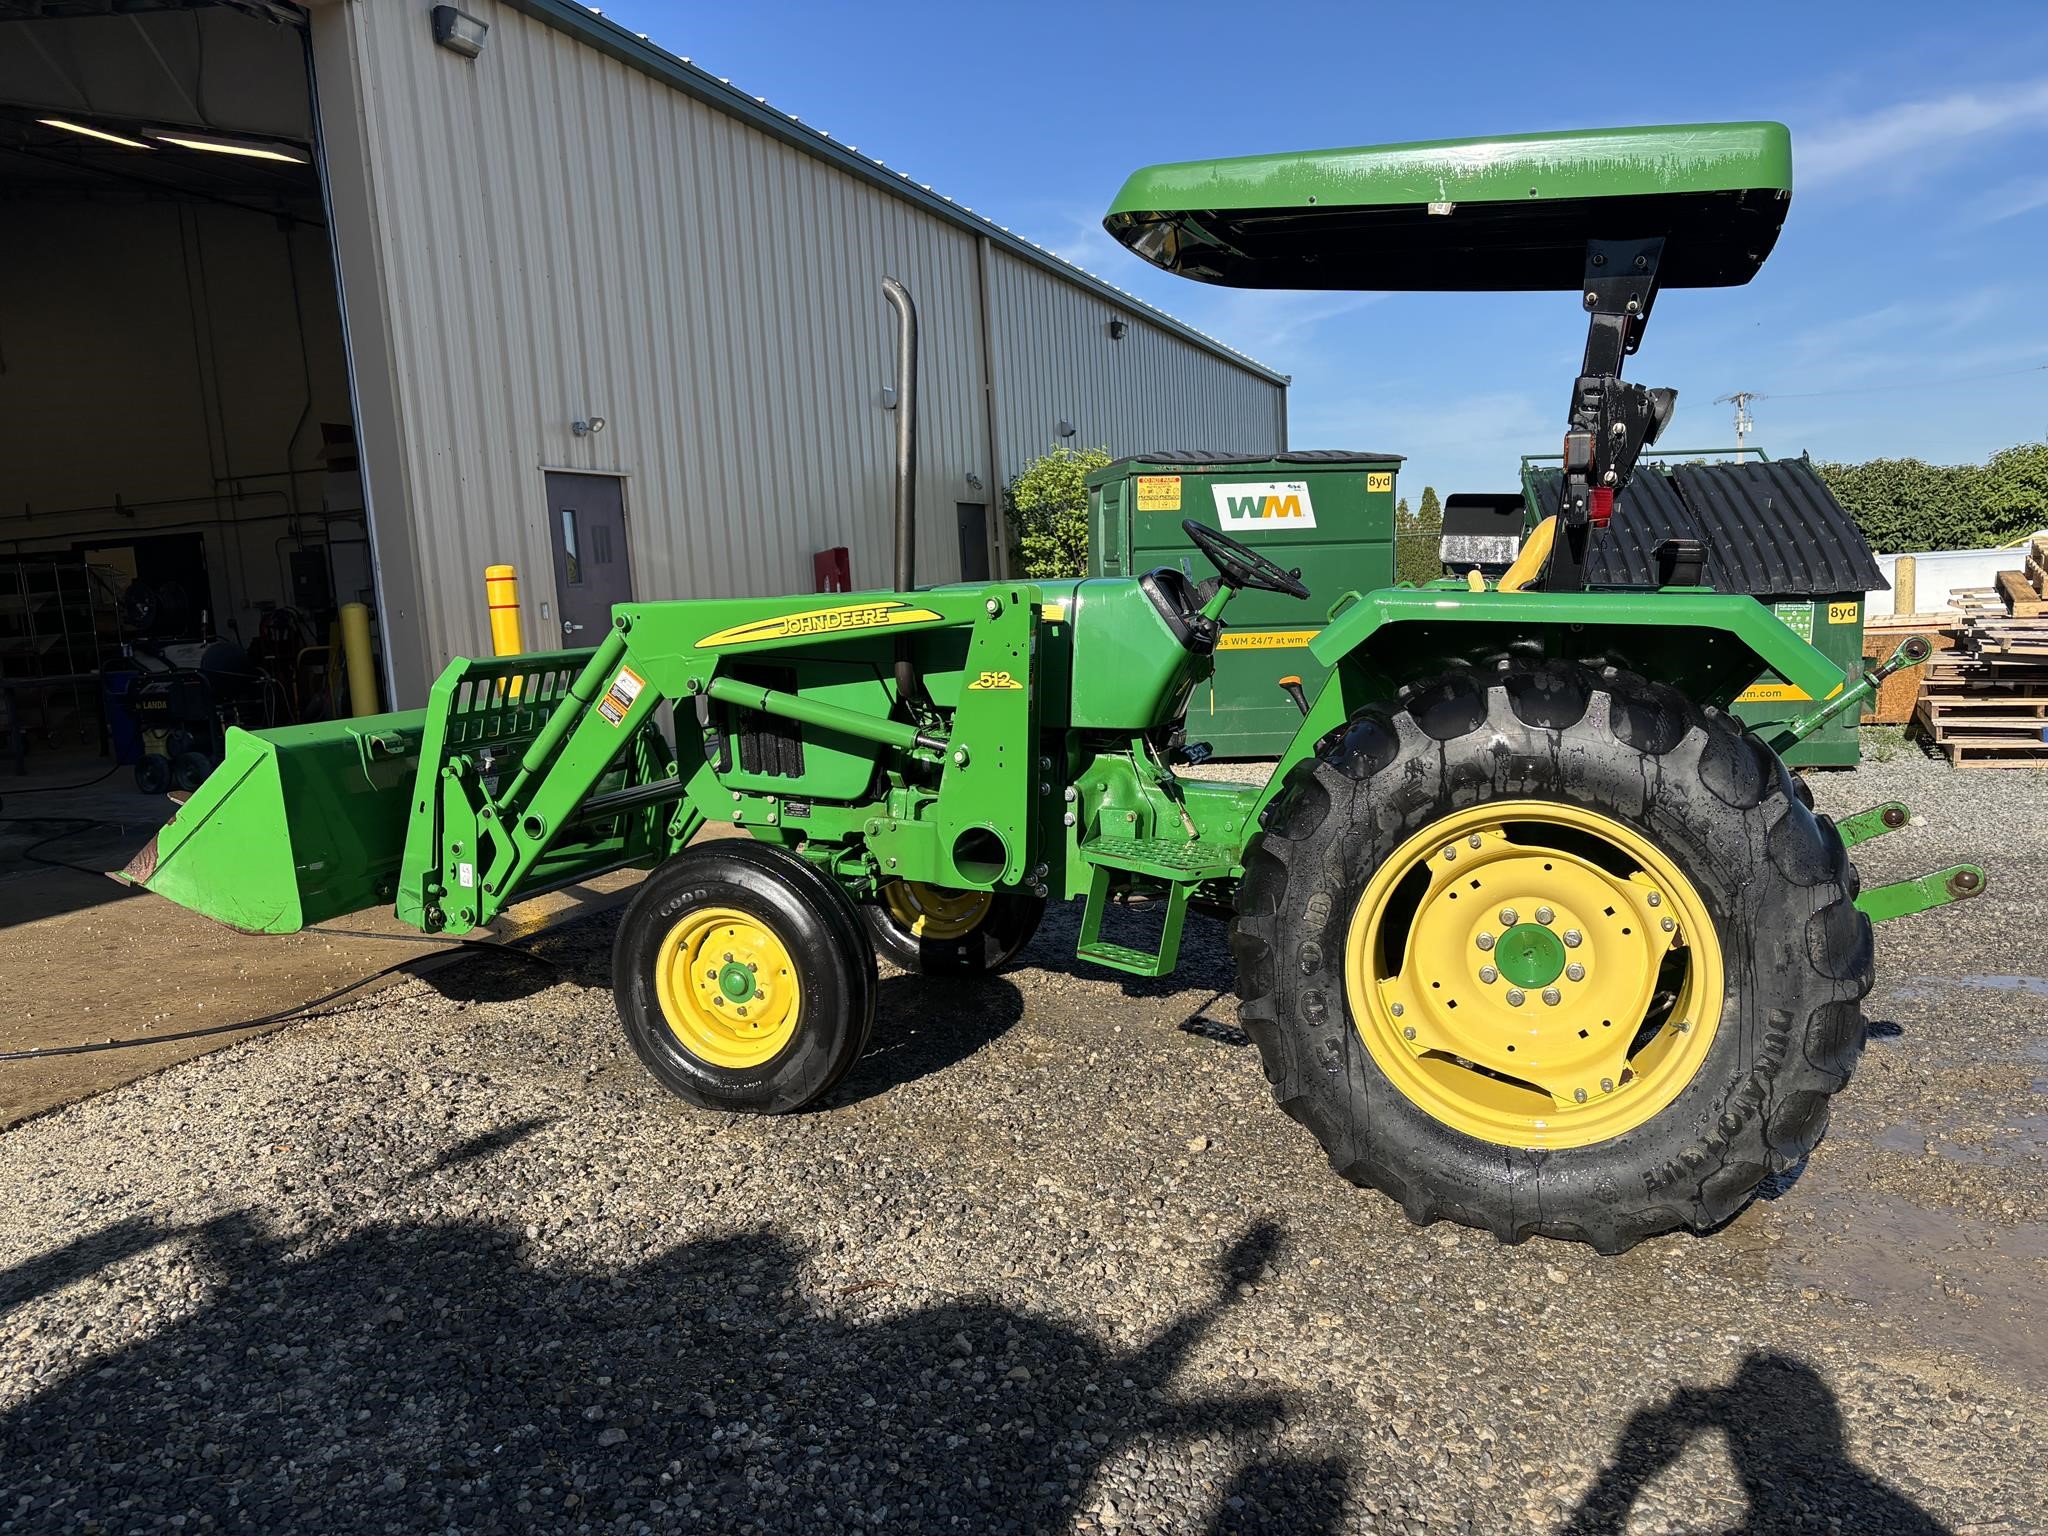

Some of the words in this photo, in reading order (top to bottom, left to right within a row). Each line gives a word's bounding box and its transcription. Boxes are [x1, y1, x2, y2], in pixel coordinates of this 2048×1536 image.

[1369, 475, 1390, 488] 8yd
[1226, 495, 1302, 519] WM
[1830, 606, 1856, 620] 8yd
[779, 616, 827, 635] JOHN
[826, 608, 889, 628] DEERE
[1231, 637, 1248, 646] WM
[1250, 636, 1273, 645] 24/7
[980, 671, 1010, 688] 512
